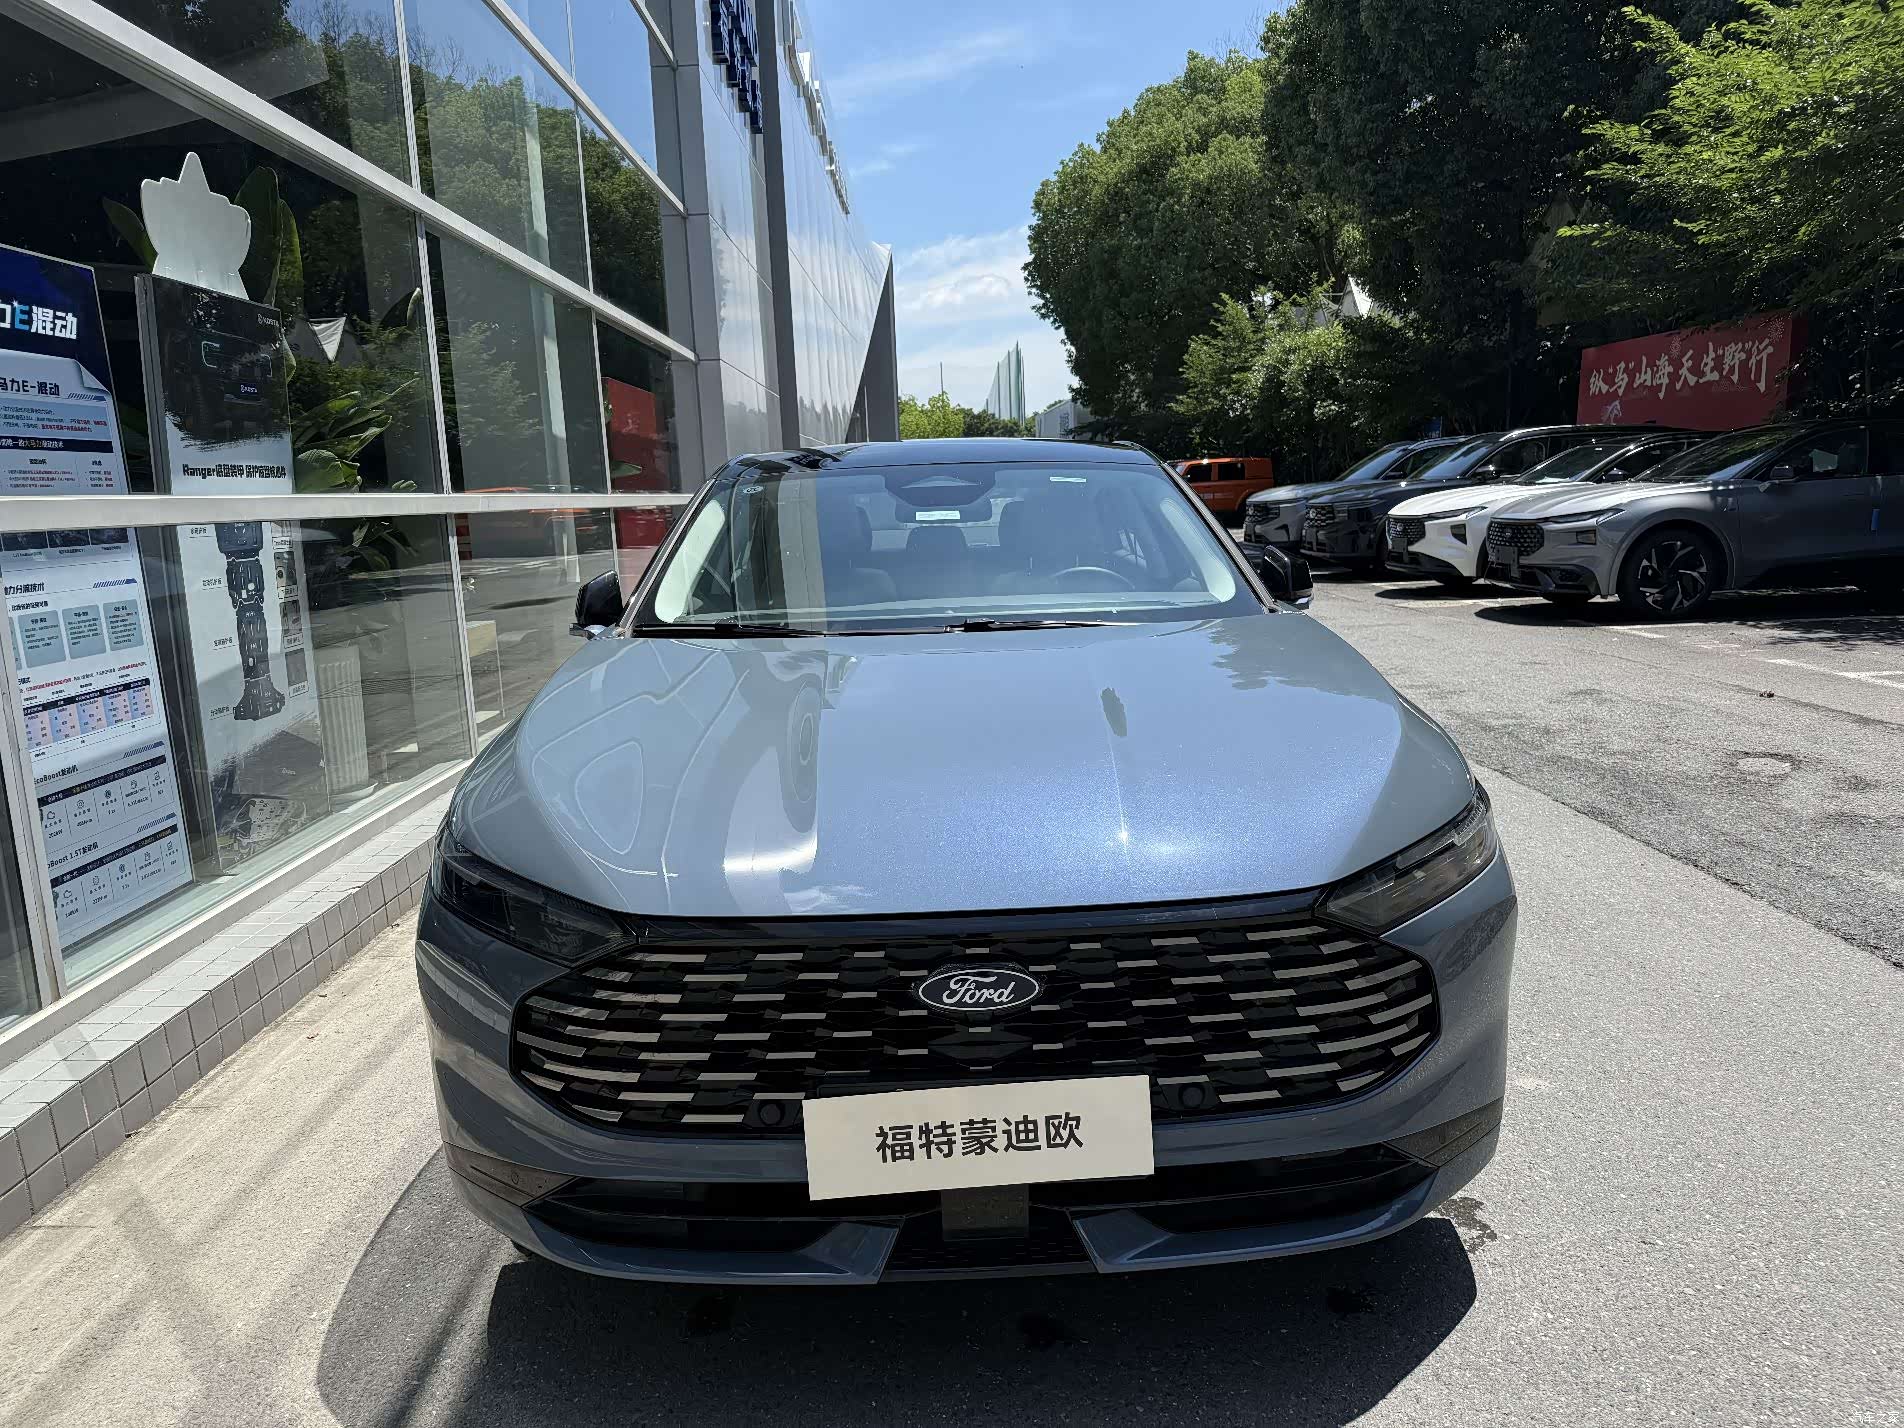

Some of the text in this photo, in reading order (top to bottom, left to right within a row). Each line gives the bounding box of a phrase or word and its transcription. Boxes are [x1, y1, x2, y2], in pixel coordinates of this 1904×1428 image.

[942, 975, 1016, 1004] Ford
[874, 1111, 1085, 1164] 福特蒙迪欧
